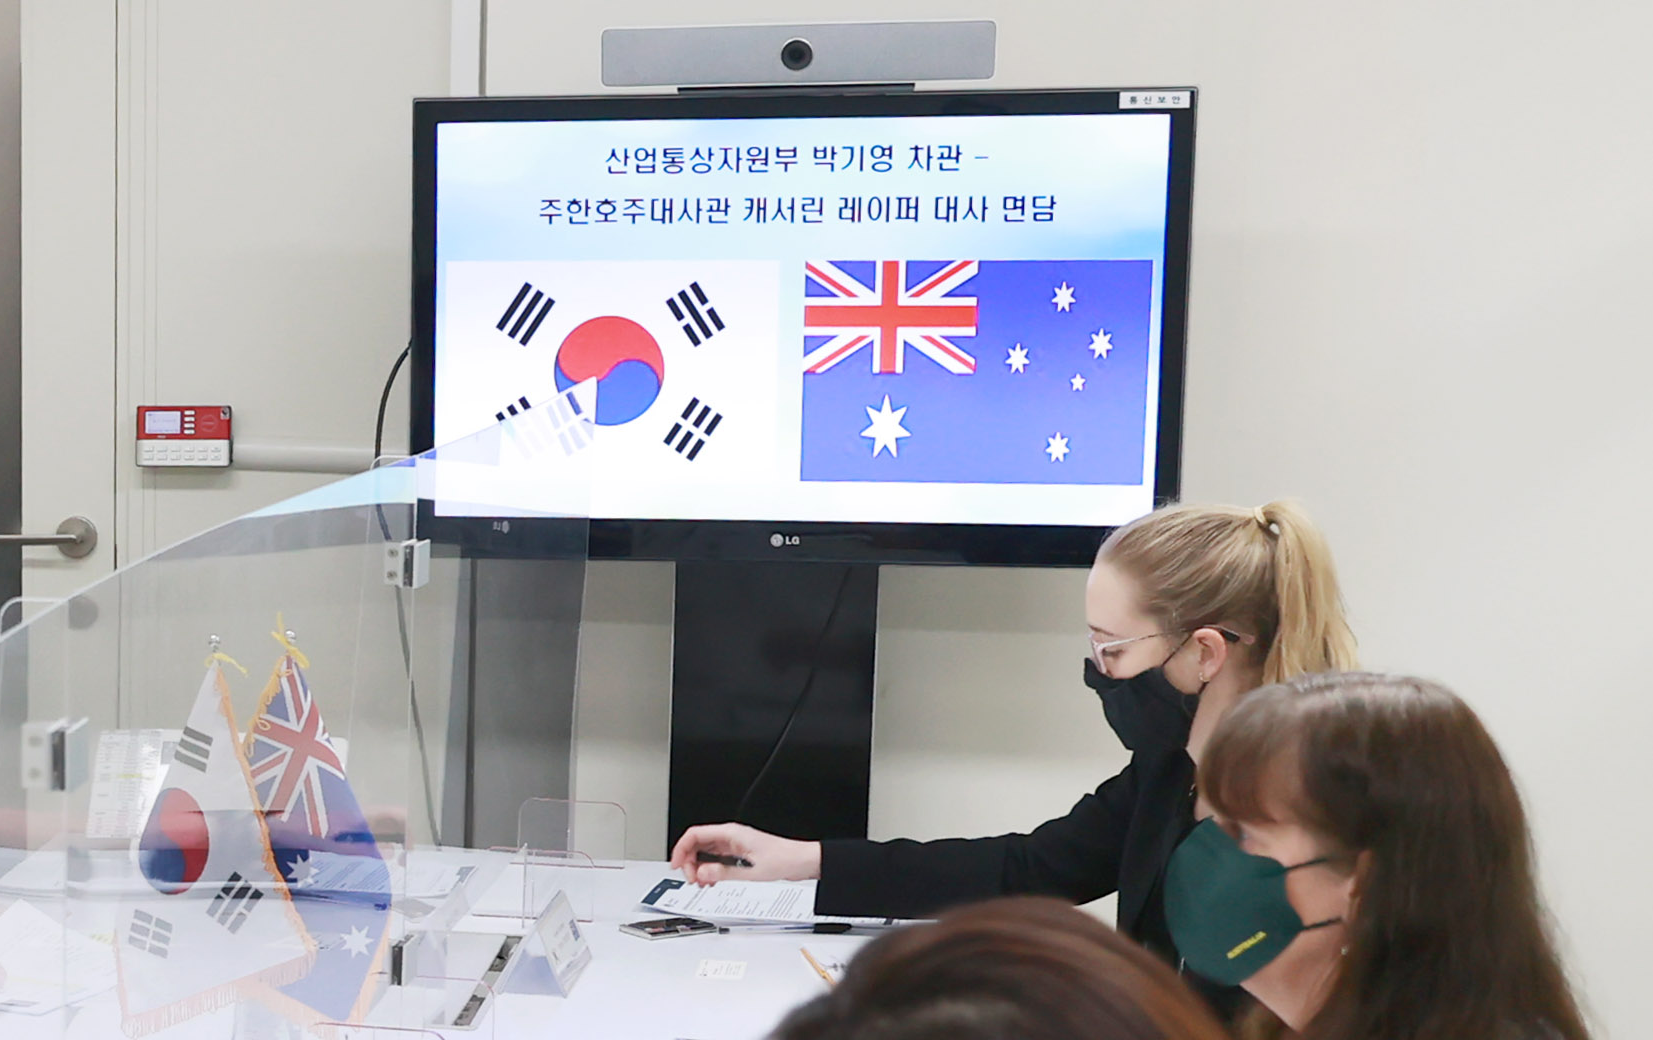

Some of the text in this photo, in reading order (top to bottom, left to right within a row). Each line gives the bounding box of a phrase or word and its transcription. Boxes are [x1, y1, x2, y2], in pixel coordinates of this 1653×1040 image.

[605, 146, 799, 175] 산업통상자원부
[812, 144, 894, 173] 박기영
[907, 144, 963, 173] 차관
[538, 194, 1058, 226] 주한호주대사관 캐서린 레이퍼 대사 면담
[785, 536, 800, 545] LG
